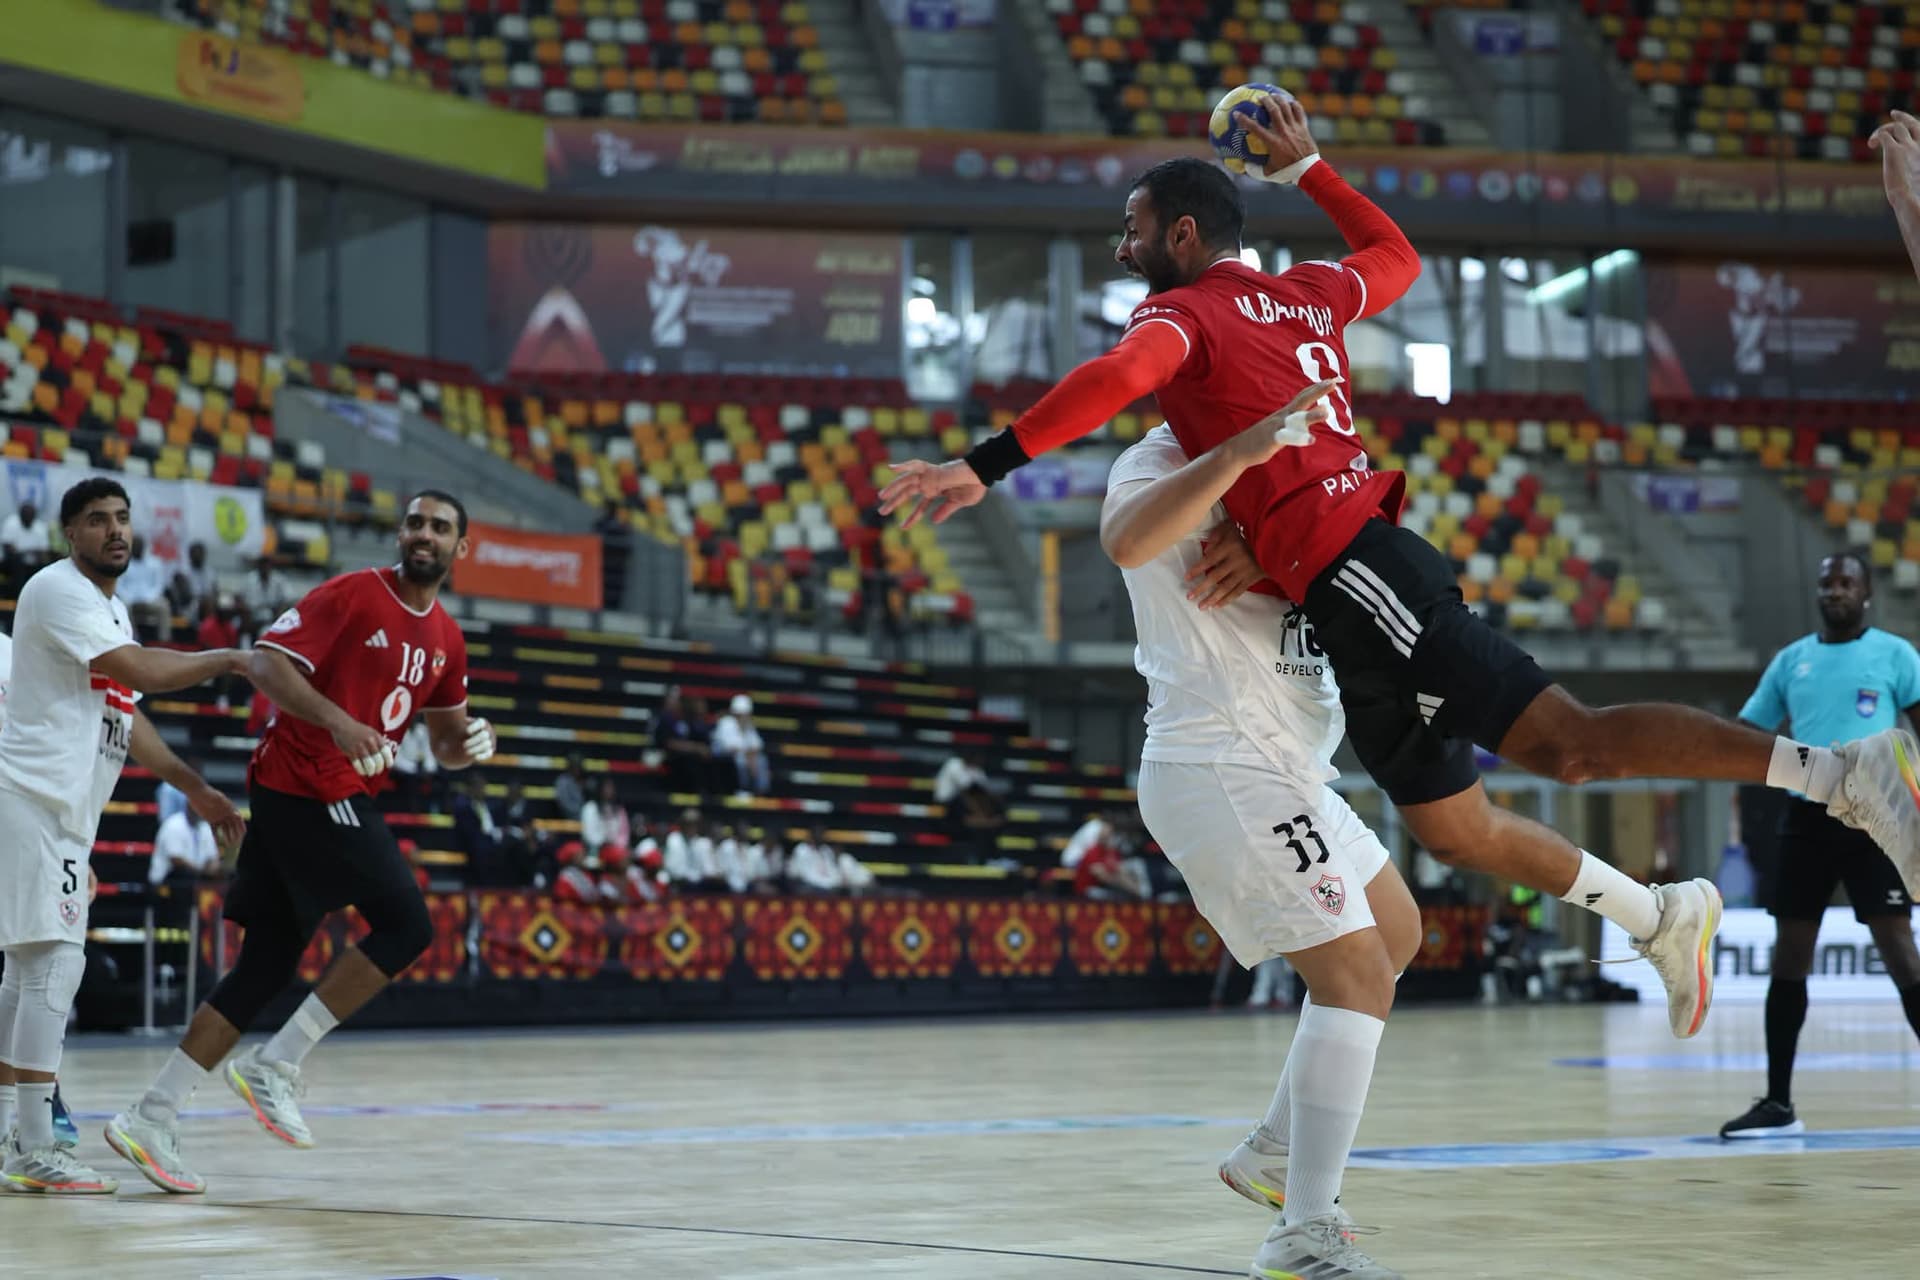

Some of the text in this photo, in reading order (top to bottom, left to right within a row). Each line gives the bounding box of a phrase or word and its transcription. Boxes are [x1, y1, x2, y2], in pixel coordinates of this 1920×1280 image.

[1296, 341, 1356, 436] 8
[397, 641, 426, 687] 18
[1275, 661, 1329, 677] DEVELO
[1272, 814, 1330, 873] 33
[62, 858, 77, 895] 5
[1713, 934, 1889, 976] hume
